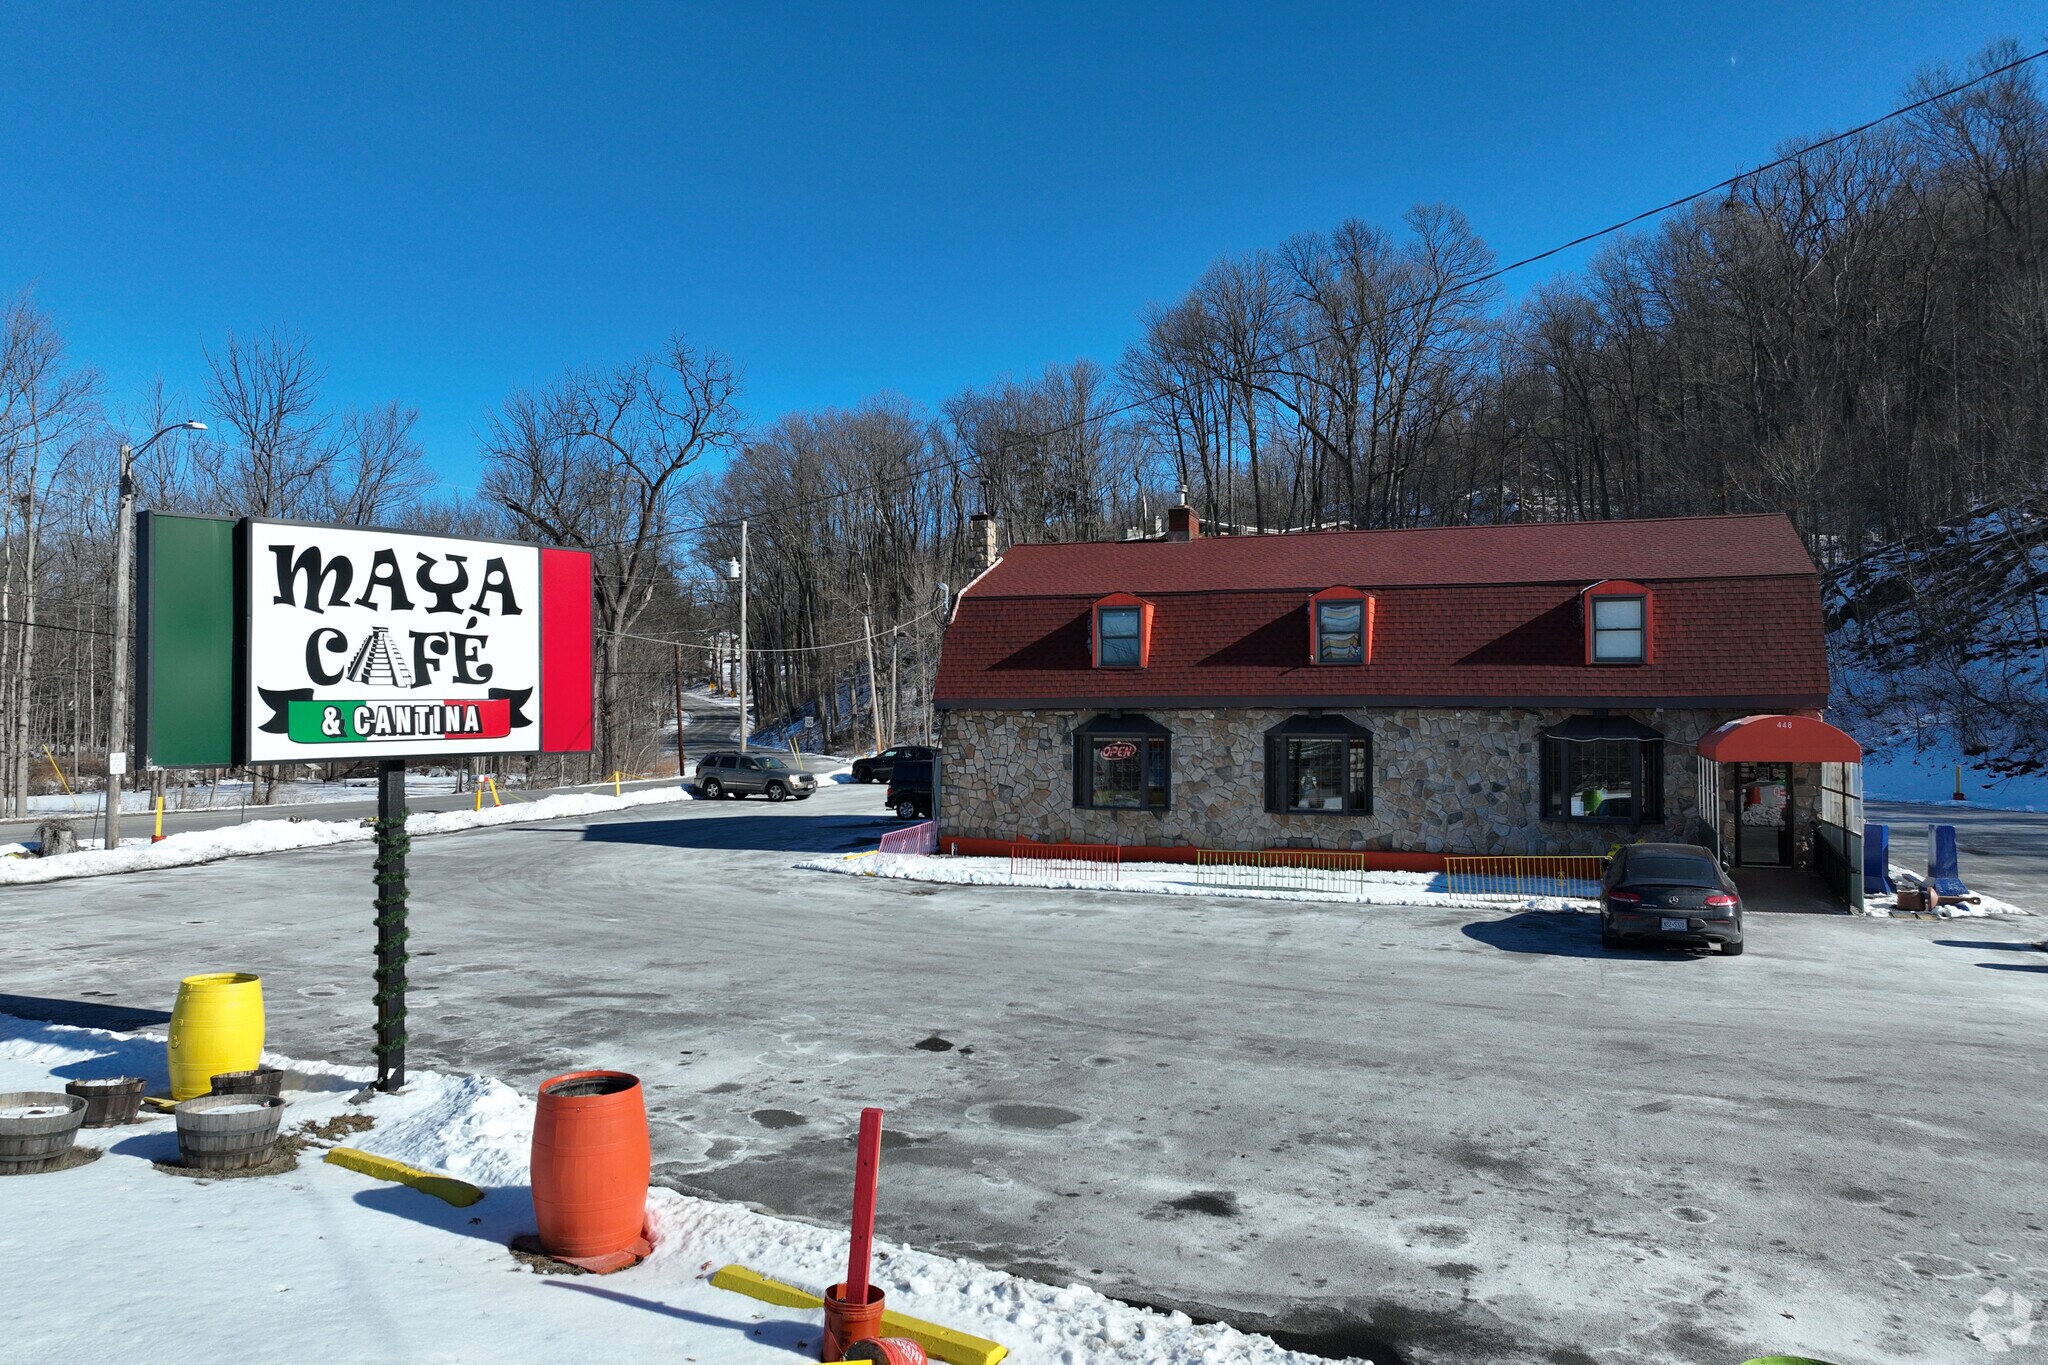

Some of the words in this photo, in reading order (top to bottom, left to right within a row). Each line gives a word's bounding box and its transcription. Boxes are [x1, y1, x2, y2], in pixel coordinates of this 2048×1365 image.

[269, 545, 522, 616] MAYA
[321, 705, 347, 737] &
[353, 704, 483, 736] CANTINA
[1776, 721, 1793, 729] 448
[1102, 746, 1132, 757] OPEN
